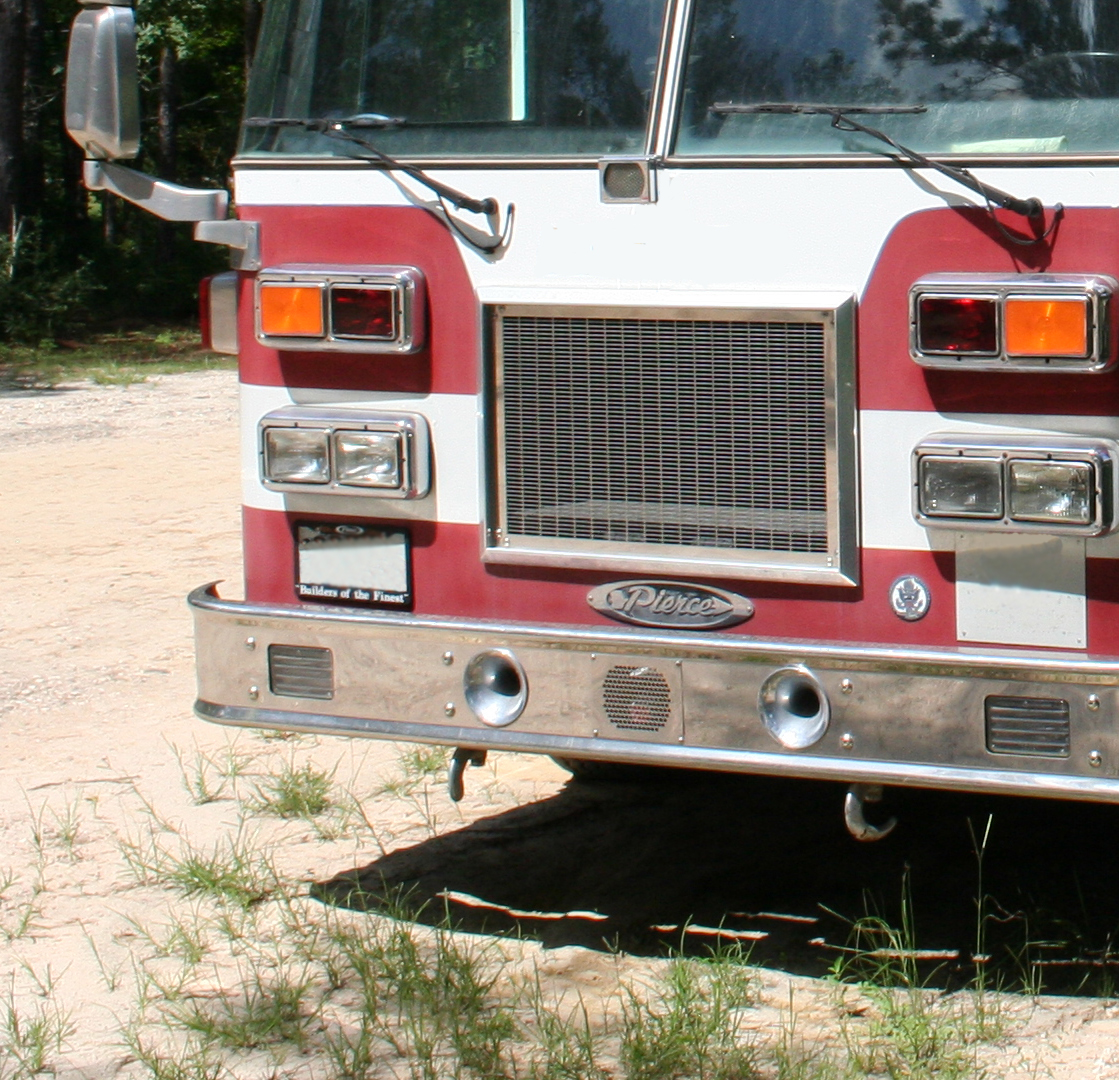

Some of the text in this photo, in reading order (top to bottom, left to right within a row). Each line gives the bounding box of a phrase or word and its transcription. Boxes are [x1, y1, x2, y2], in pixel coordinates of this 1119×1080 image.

[340, 589, 351, 599] of
[354, 590, 370, 600] the
[625, 585, 717, 616] Pierce
